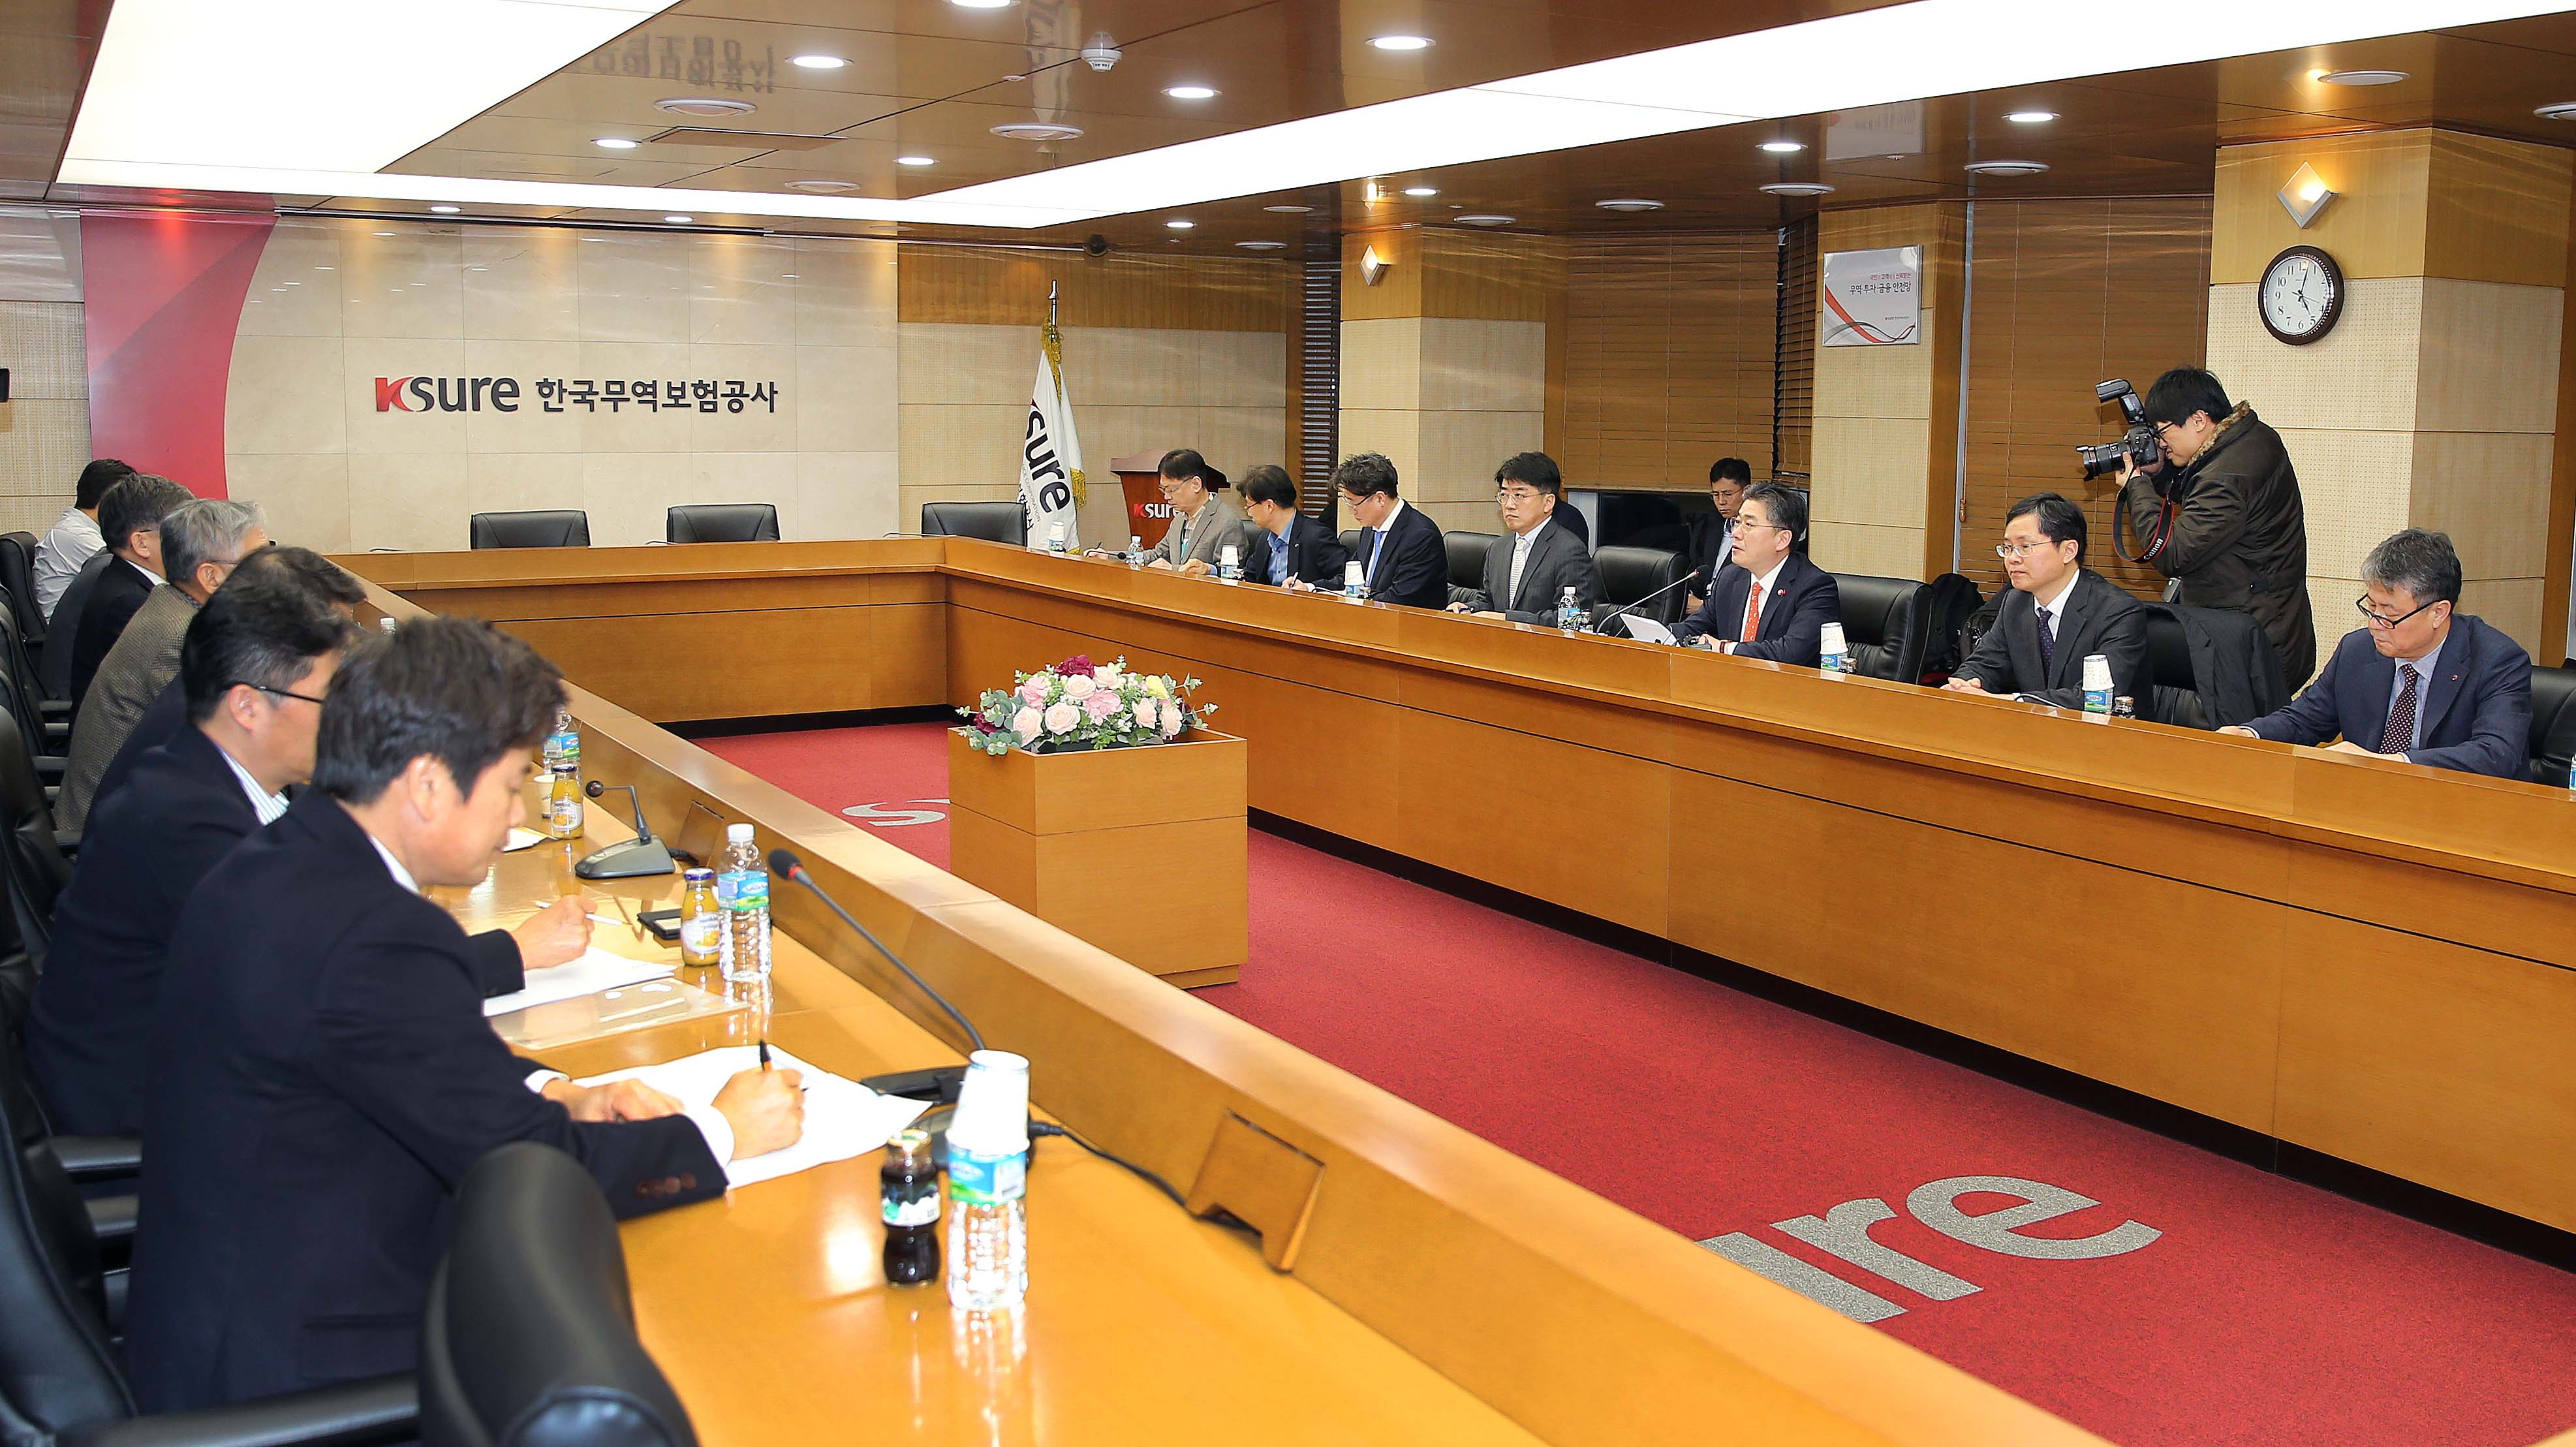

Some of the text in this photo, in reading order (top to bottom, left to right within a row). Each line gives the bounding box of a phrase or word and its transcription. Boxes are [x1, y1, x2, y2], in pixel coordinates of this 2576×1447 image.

[2288, 266, 2294, 275] 11
[2299, 261, 2307, 271] 12
[1893, 281, 1911, 293] 안전망
[2278, 277, 2286, 287] 10
[2275, 291, 2281, 300] 9
[2277, 305, 2284, 316] 8
[2286, 317, 2291, 326] 7
[2298, 320, 2304, 329] 6
[2310, 316, 2316, 325] 5
[535, 378, 779, 413] 한국무역보험공사
[1025, 398, 1070, 513] sure
[1133, 502, 1177, 519] Ksur
[2143, 538, 2164, 560] Canon
